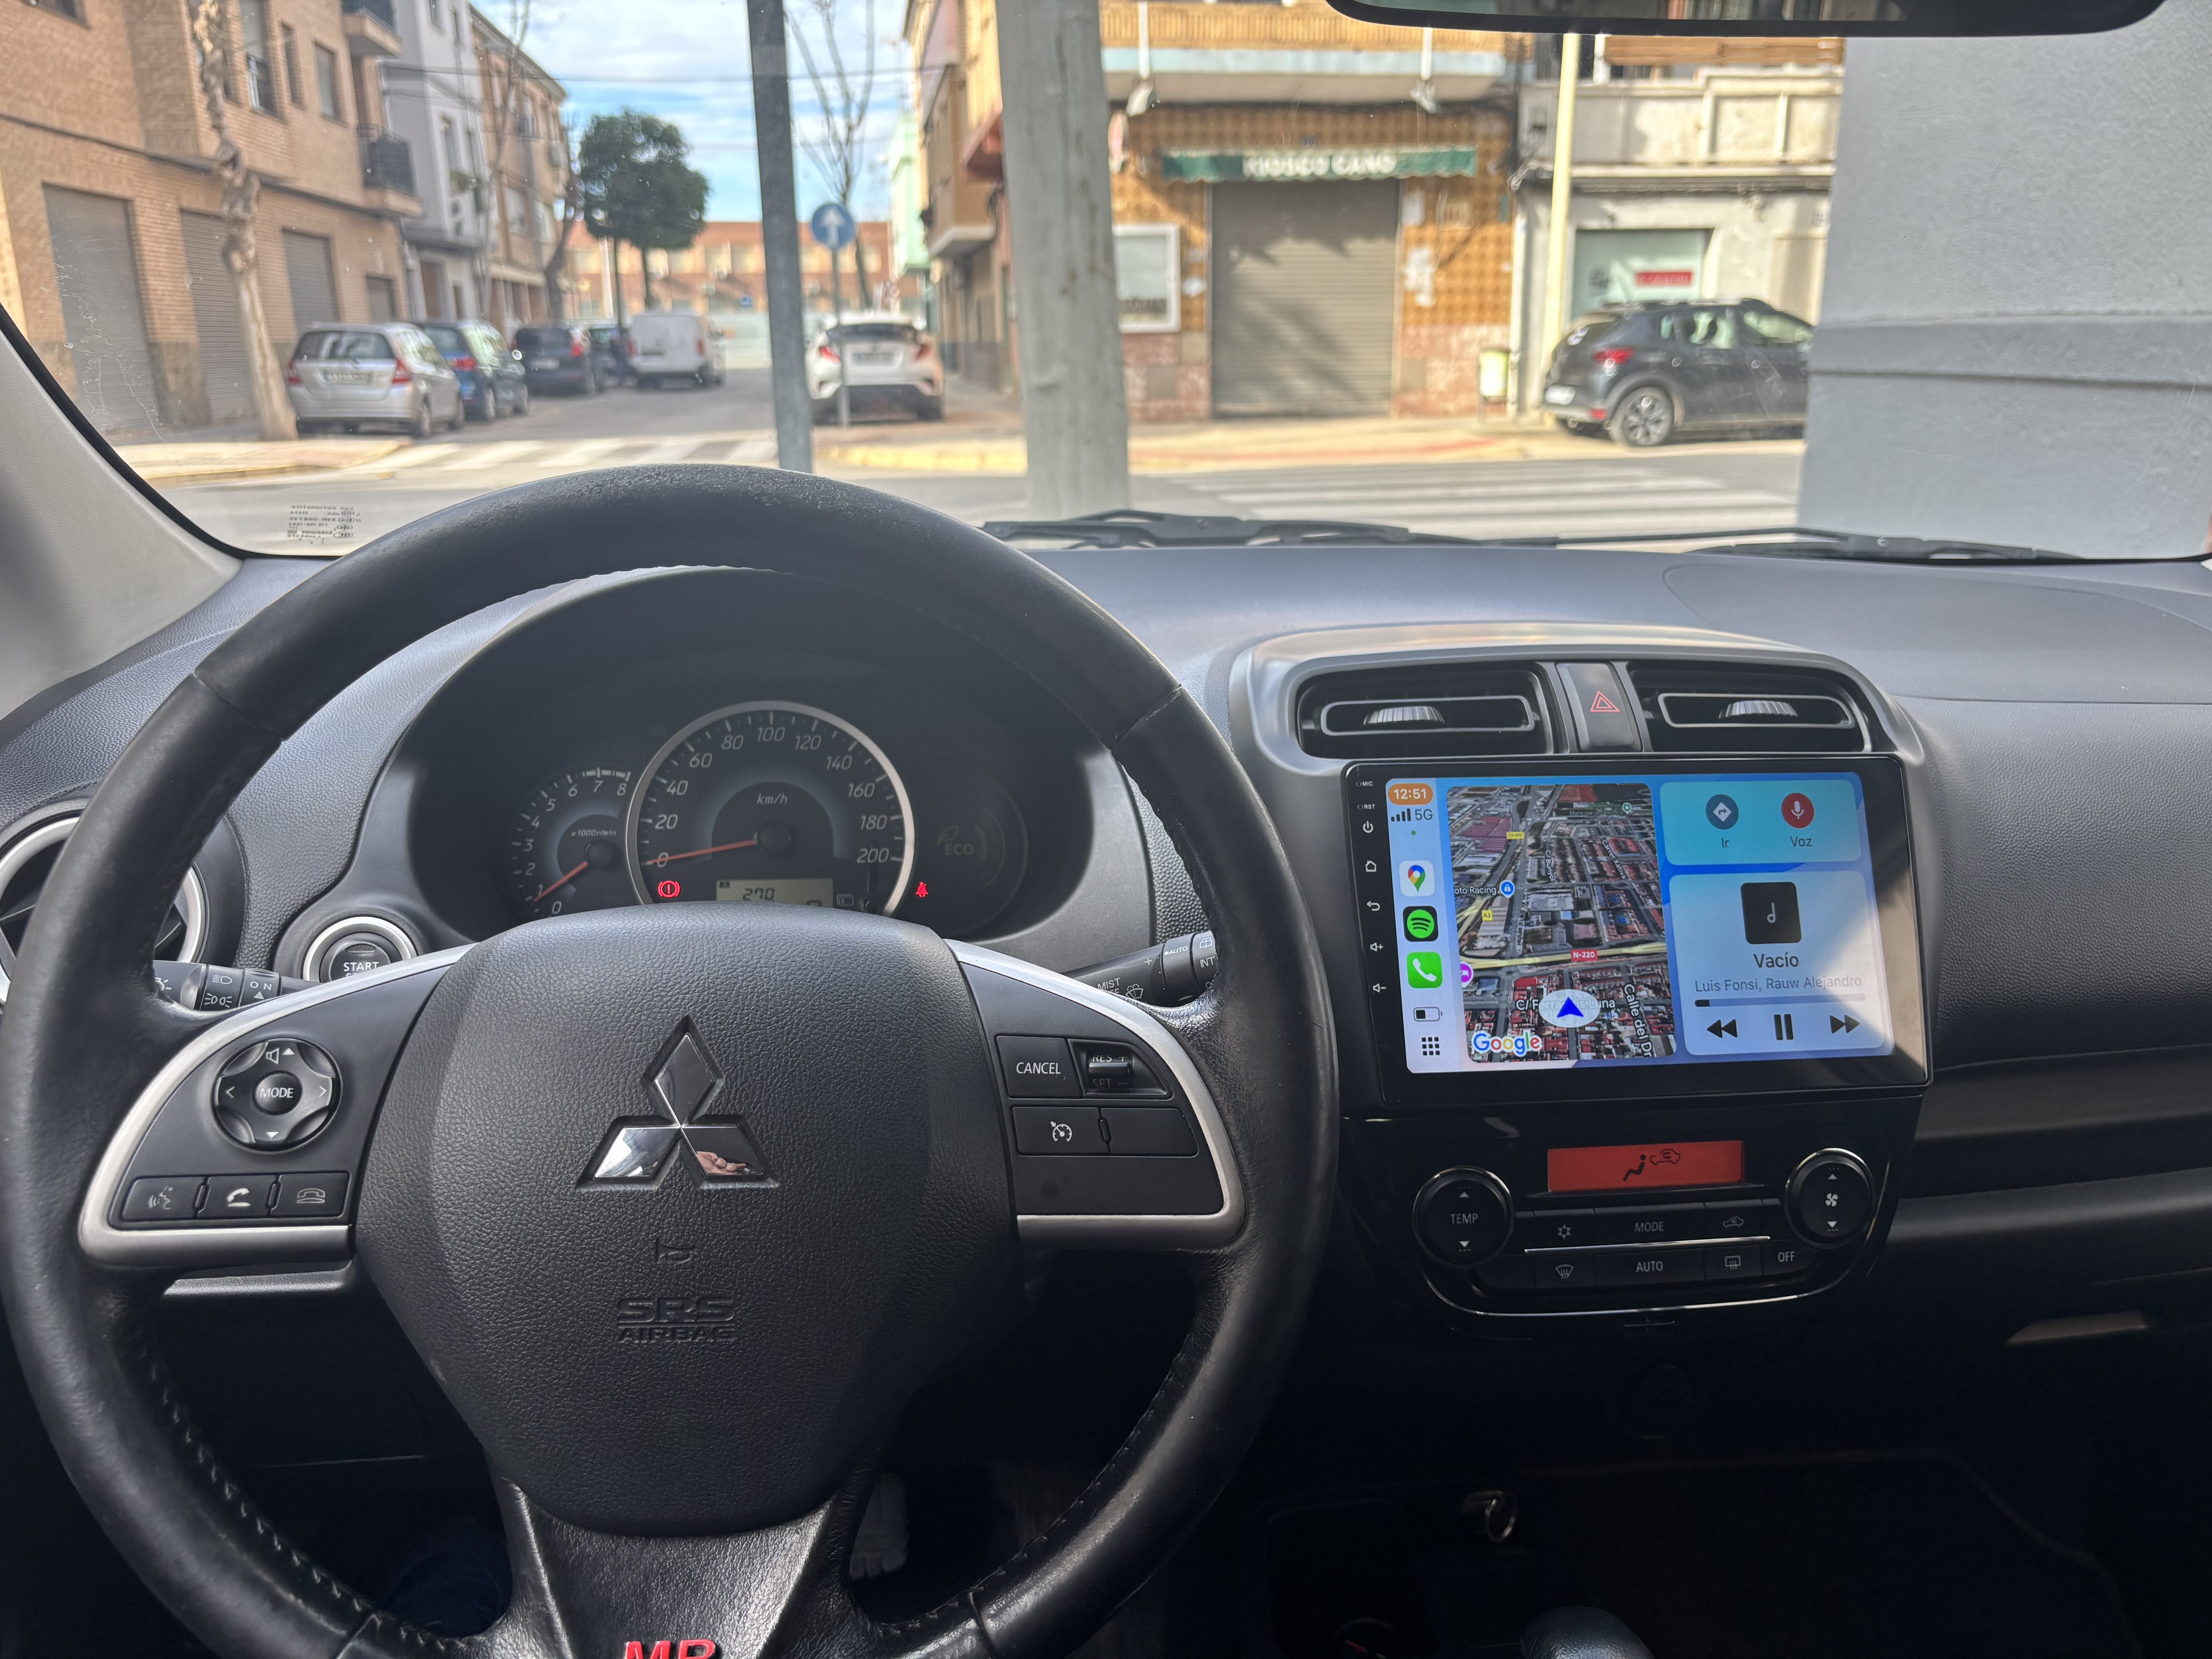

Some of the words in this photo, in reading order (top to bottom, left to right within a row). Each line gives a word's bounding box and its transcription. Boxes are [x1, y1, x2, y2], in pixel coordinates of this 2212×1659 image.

[757, 727, 785, 742] 100
[721, 735, 744, 750] 80
[795, 735, 821, 750] 120
[689, 752, 713, 768] 60
[826, 755, 853, 771] 140
[568, 784, 578, 797] 6
[594, 780, 603, 793] 7
[617, 782, 627, 796] 8
[666, 780, 689, 795] 40
[848, 782, 875, 798] 160
[756, 793, 788, 805] km/h
[1393, 788, 1427, 800] 12:51
[546, 798, 556, 812] 5
[654, 814, 678, 829] 20
[1415, 809, 1433, 821] 5G
[531, 815, 540, 829] 4
[860, 814, 888, 830] 180
[523, 838, 534, 852] 3
[1721, 837, 1729, 849] Ir
[1790, 835, 1812, 847] Voz
[945, 843, 974, 855] ECO
[1602, 840, 1616, 859] Carrer
[657, 852, 669, 868] 0
[857, 848, 889, 864] 200
[525, 862, 536, 876] 2
[538, 884, 544, 896] 1
[742, 887, 775, 901] 270
[1469, 886, 1497, 896] Racing
[551, 901, 562, 914] 0
[1169, 946, 1188, 955] AUTO
[1200, 956, 1216, 968] INT
[1753, 951, 1799, 968] Vacío
[343, 961, 380, 972] START
[250, 981, 272, 990] ON
[1097, 977, 1120, 990] MIST
[1694, 979, 1721, 993] Luis
[1724, 977, 1762, 992] Fonsi,
[1766, 977, 1799, 989] Rauw
[1804, 975, 1862, 991] Alejandro
[1516, 999, 1528, 1011] C/
[1624, 984, 1640, 1016] Calle
[1634, 1019, 1649, 1040] del
[1473, 1032, 1541, 1055] Google
[1092, 1054, 1112, 1062] RES
[1016, 1062, 1061, 1074] CANCEL
[1092, 1078, 1112, 1088] SET
[260, 1087, 294, 1098] MODE
[1450, 1213, 1479, 1224] TEMP
[1634, 1221, 1664, 1233] MODE
[1778, 1251, 1796, 1262] OFF
[1636, 1260, 1664, 1273] AUTO
[618, 1298, 735, 1323] SRS
[620, 1328, 736, 1343] AIRBAG
